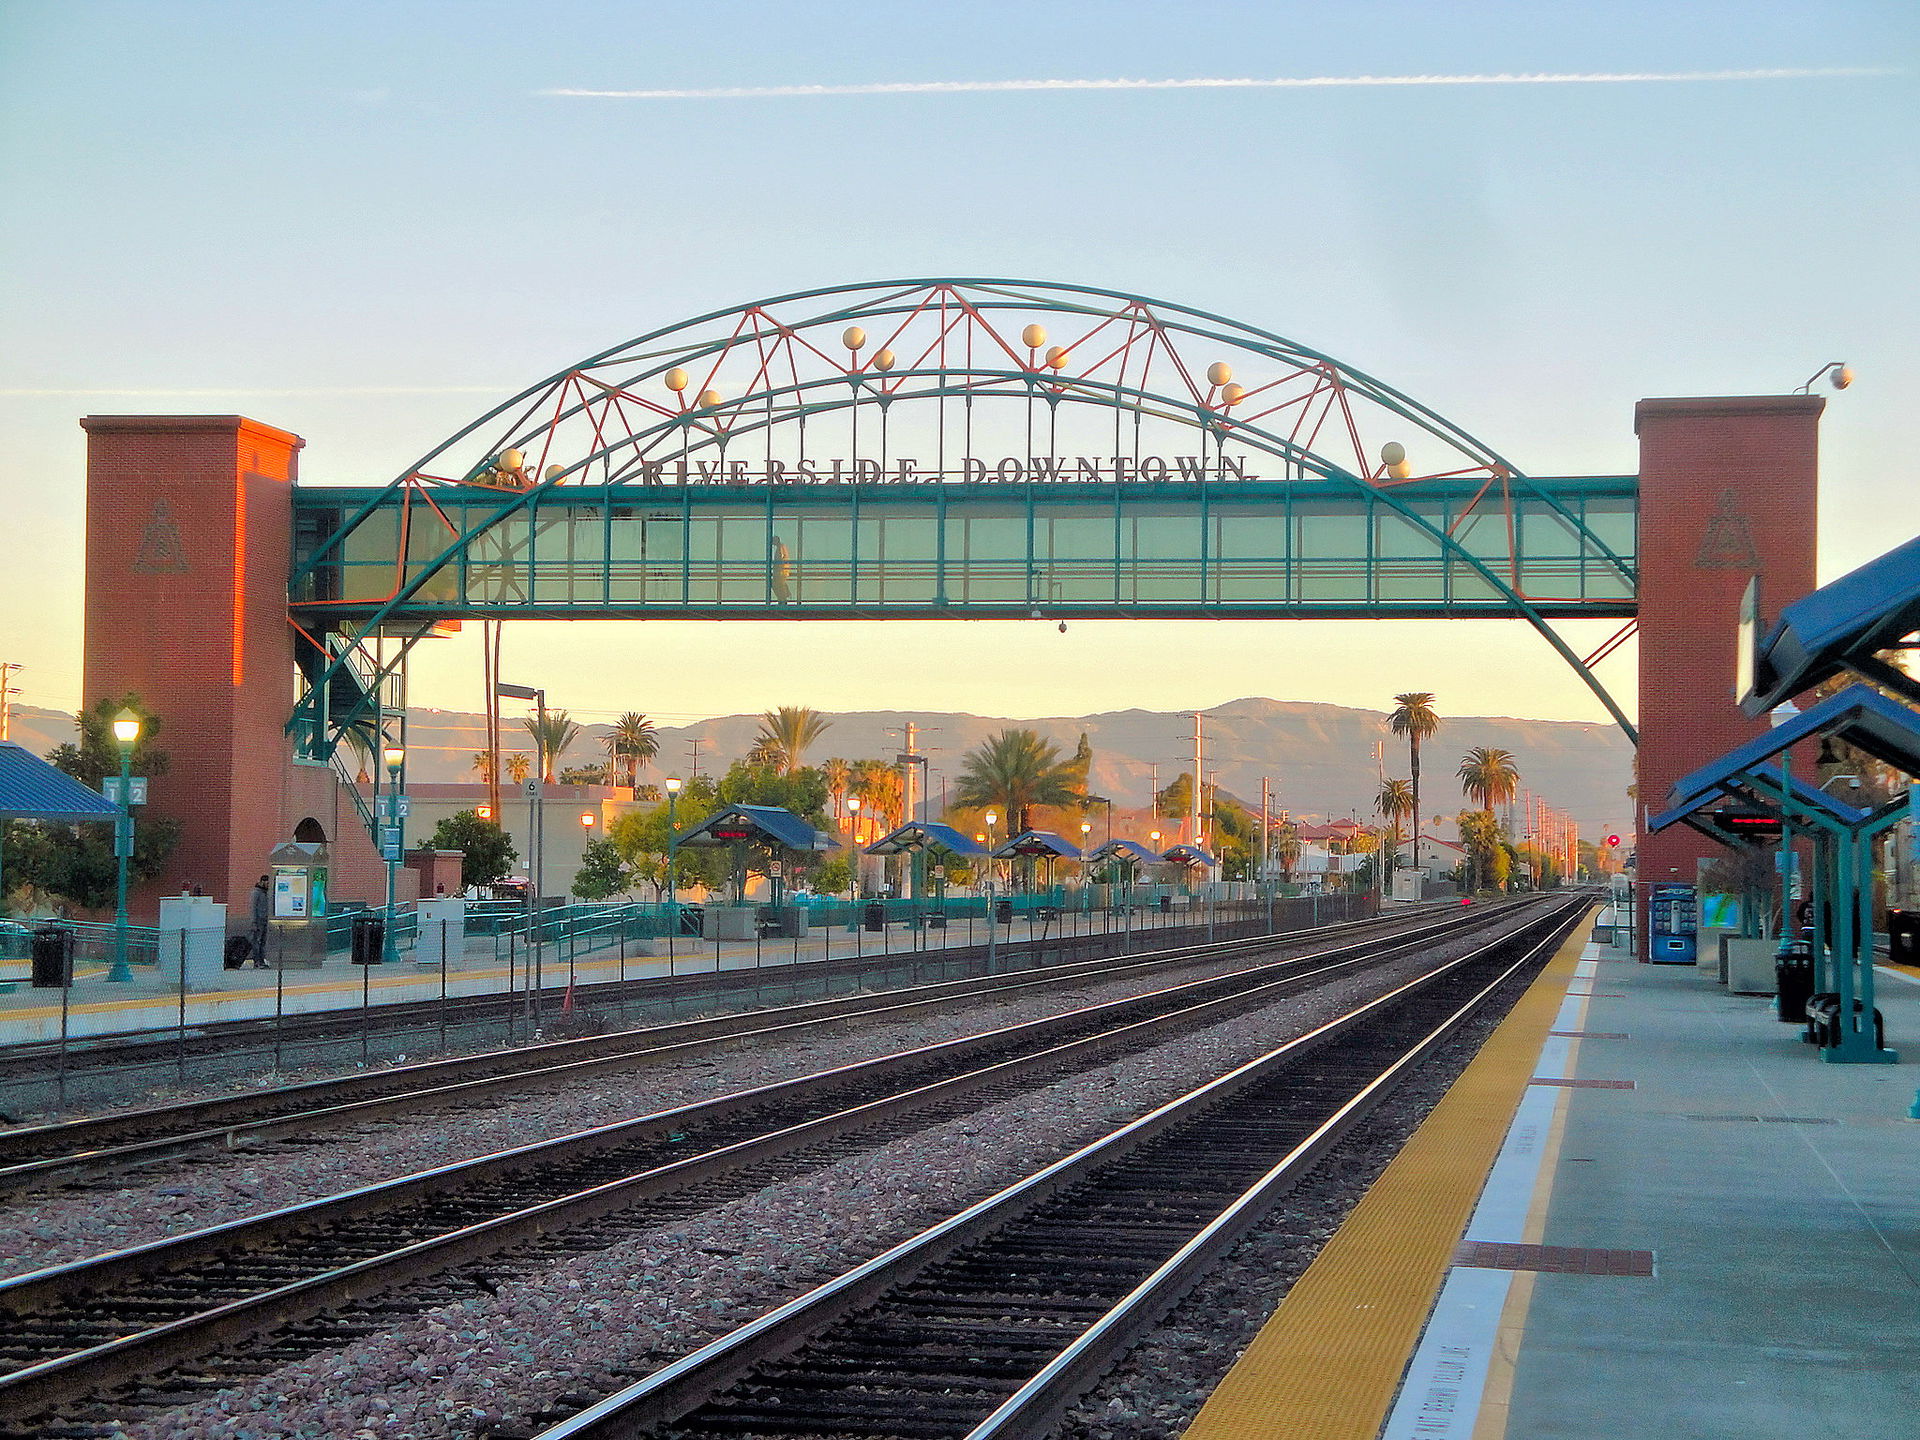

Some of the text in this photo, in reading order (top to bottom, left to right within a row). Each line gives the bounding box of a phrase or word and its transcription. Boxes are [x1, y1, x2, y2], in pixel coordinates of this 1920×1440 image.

[642, 456, 1247, 486] RIVERSIDE DOWNTOWN
[528, 781, 535, 791] 6
[109, 788, 115, 802] 1
[133, 788, 143, 802] 2
[380, 804, 385, 816] 1
[399, 804, 408, 816] 2
